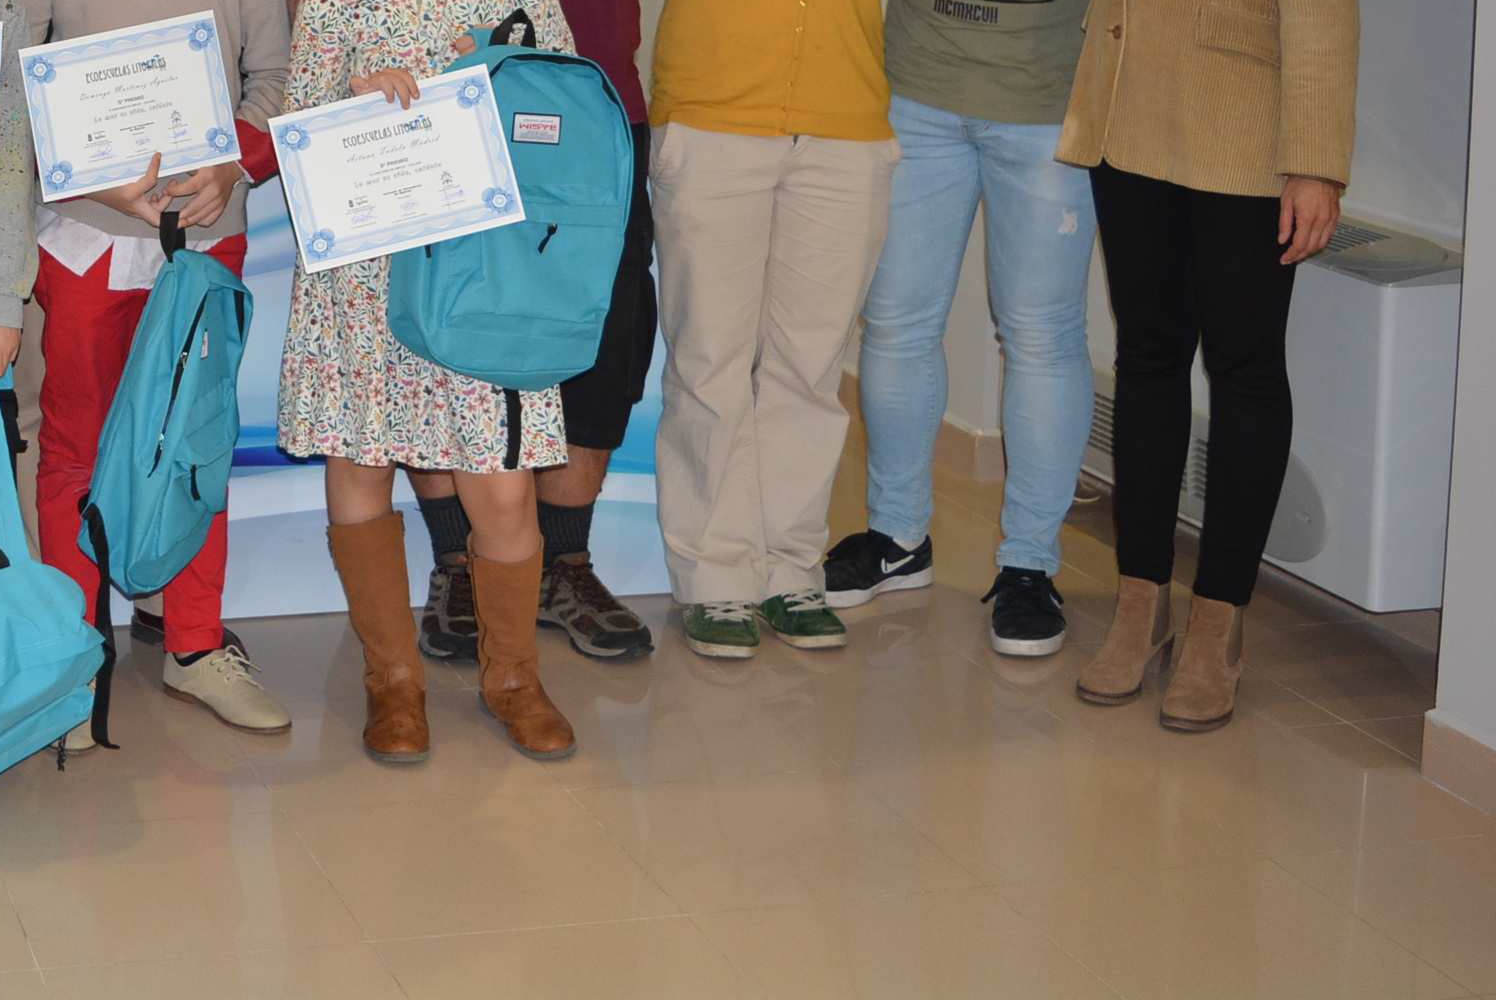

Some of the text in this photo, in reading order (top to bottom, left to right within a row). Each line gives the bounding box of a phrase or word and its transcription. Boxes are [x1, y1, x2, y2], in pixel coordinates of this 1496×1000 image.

[85, 64, 131, 84] ECOESCUELAS
[124, 95, 145, 103] PREMIO
[342, 126, 392, 148] ECOESCUELAS
[386, 157, 409, 167] PREMIO
